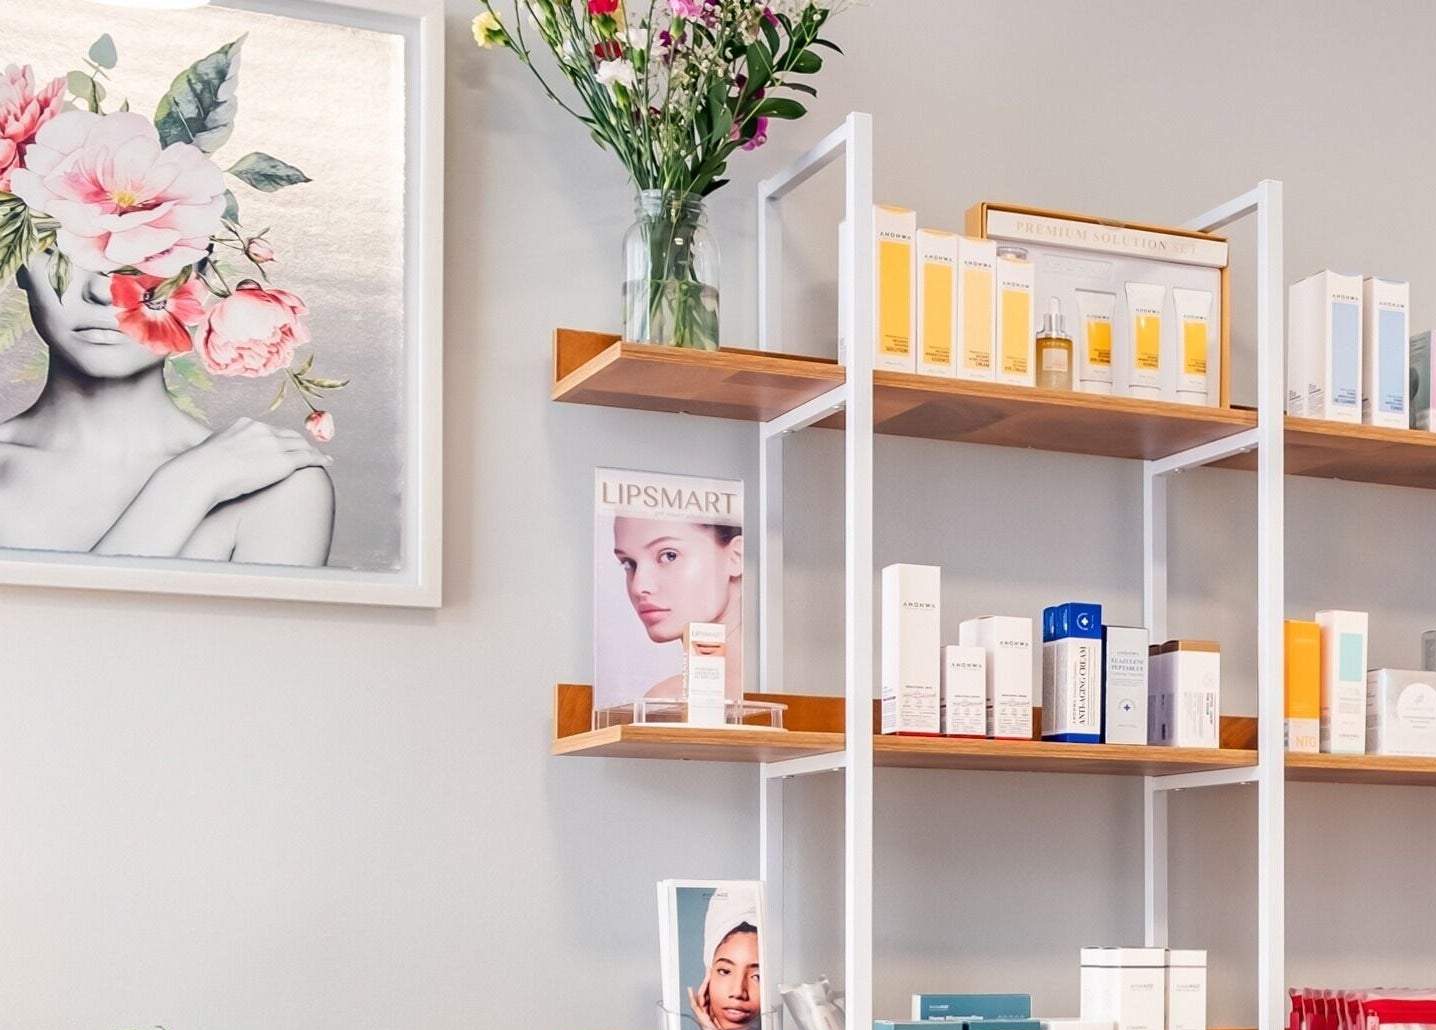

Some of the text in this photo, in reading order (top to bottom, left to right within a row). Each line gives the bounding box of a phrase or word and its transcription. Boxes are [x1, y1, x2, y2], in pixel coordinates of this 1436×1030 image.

[1017, 221, 1087, 241] PREMIUM
[1093, 233, 1167, 250] SOLUTION
[602, 482, 737, 515] LIPSMART
